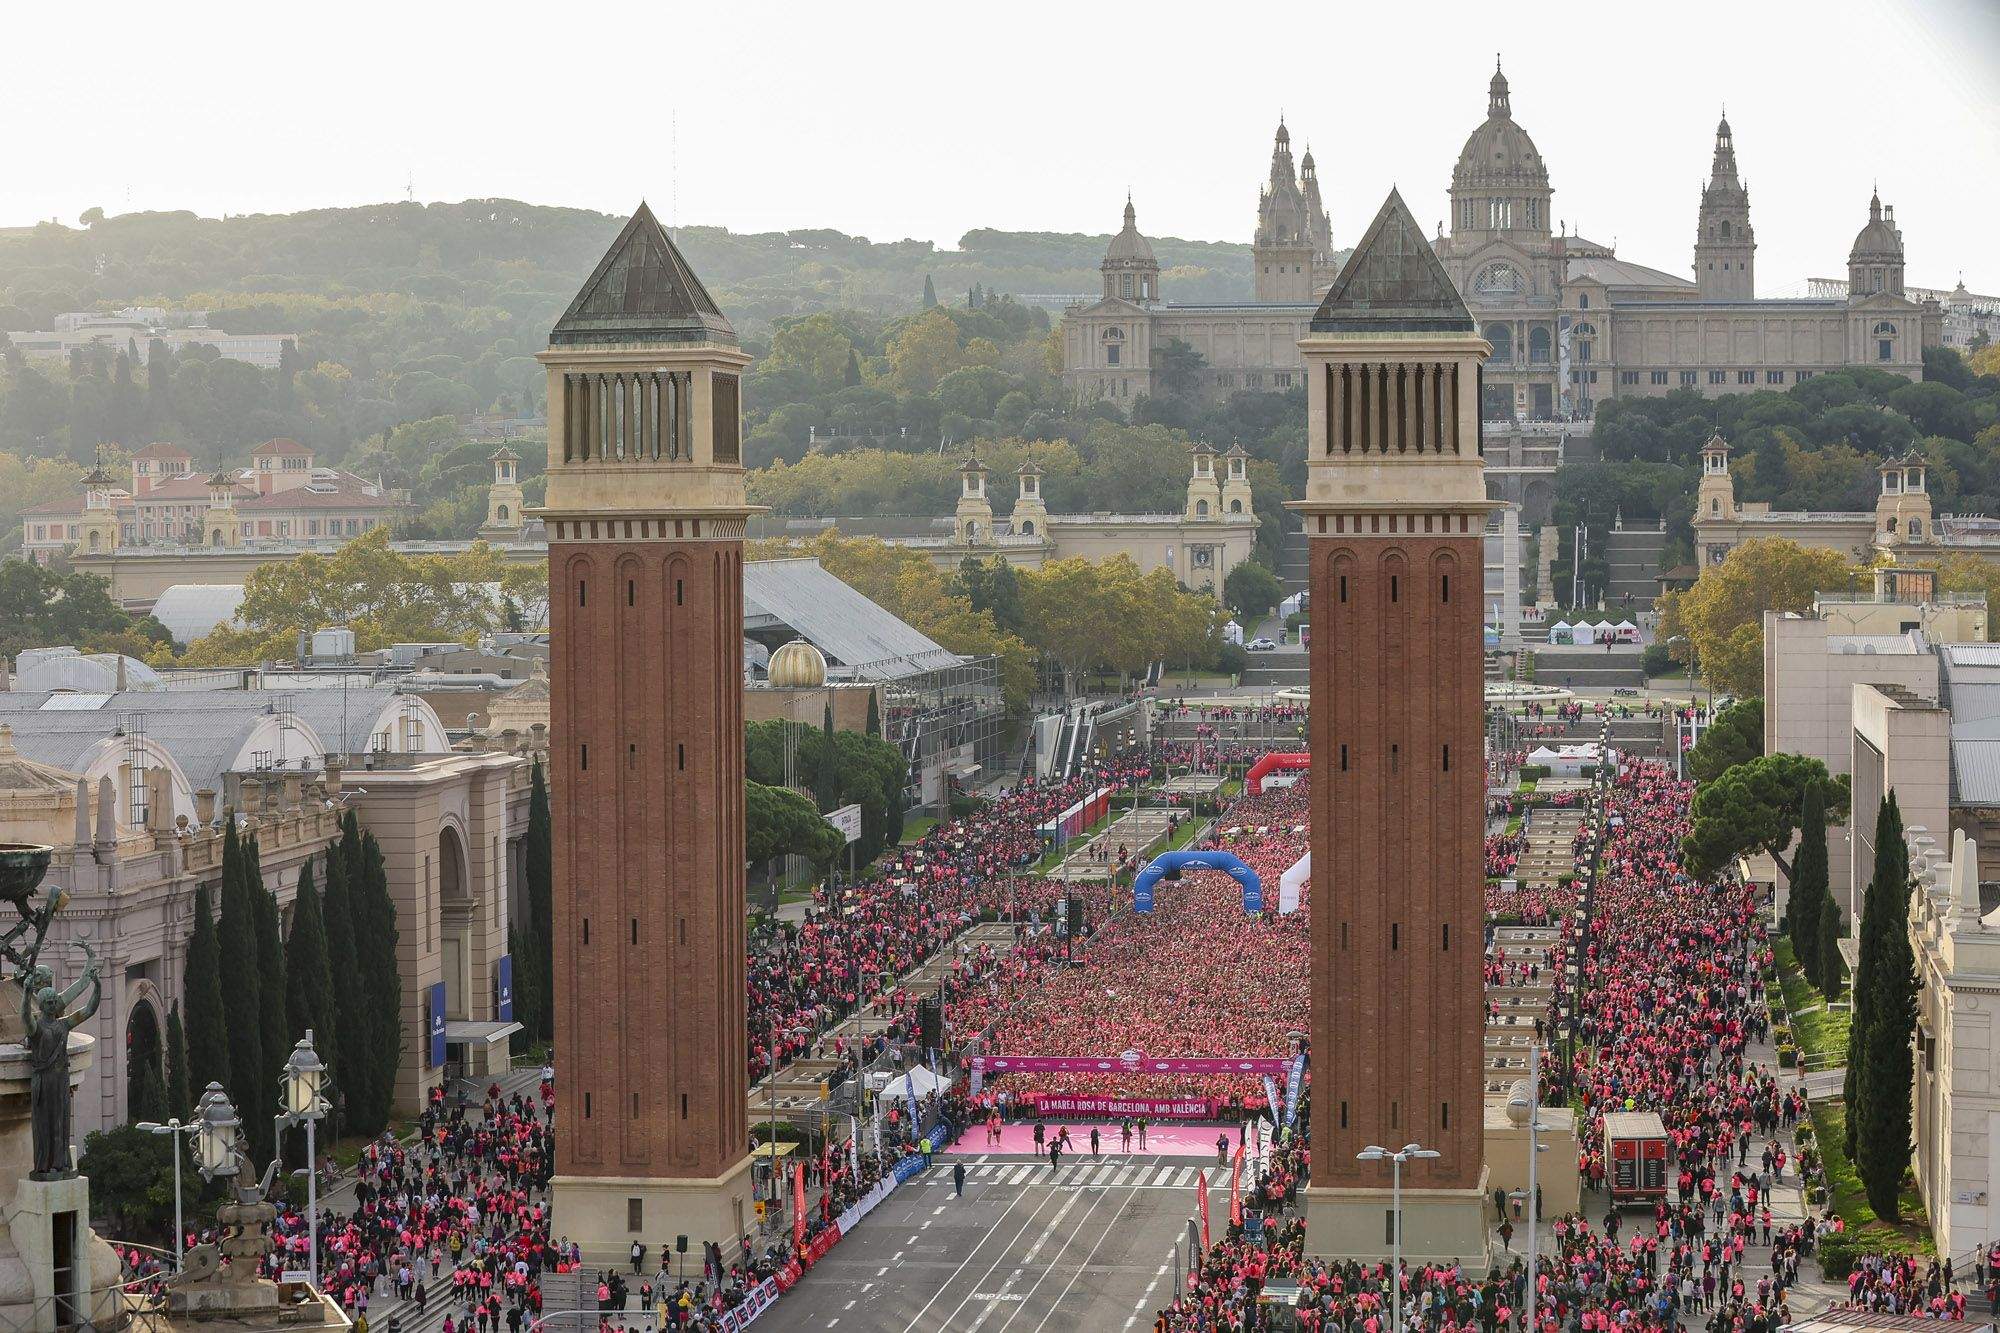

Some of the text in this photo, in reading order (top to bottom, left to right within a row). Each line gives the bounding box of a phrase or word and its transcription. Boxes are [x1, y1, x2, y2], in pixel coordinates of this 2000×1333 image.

[1040, 1100, 1206, 1114] LA MAREA ROSA DE BARCELONA, AMB VALÈNCIA
